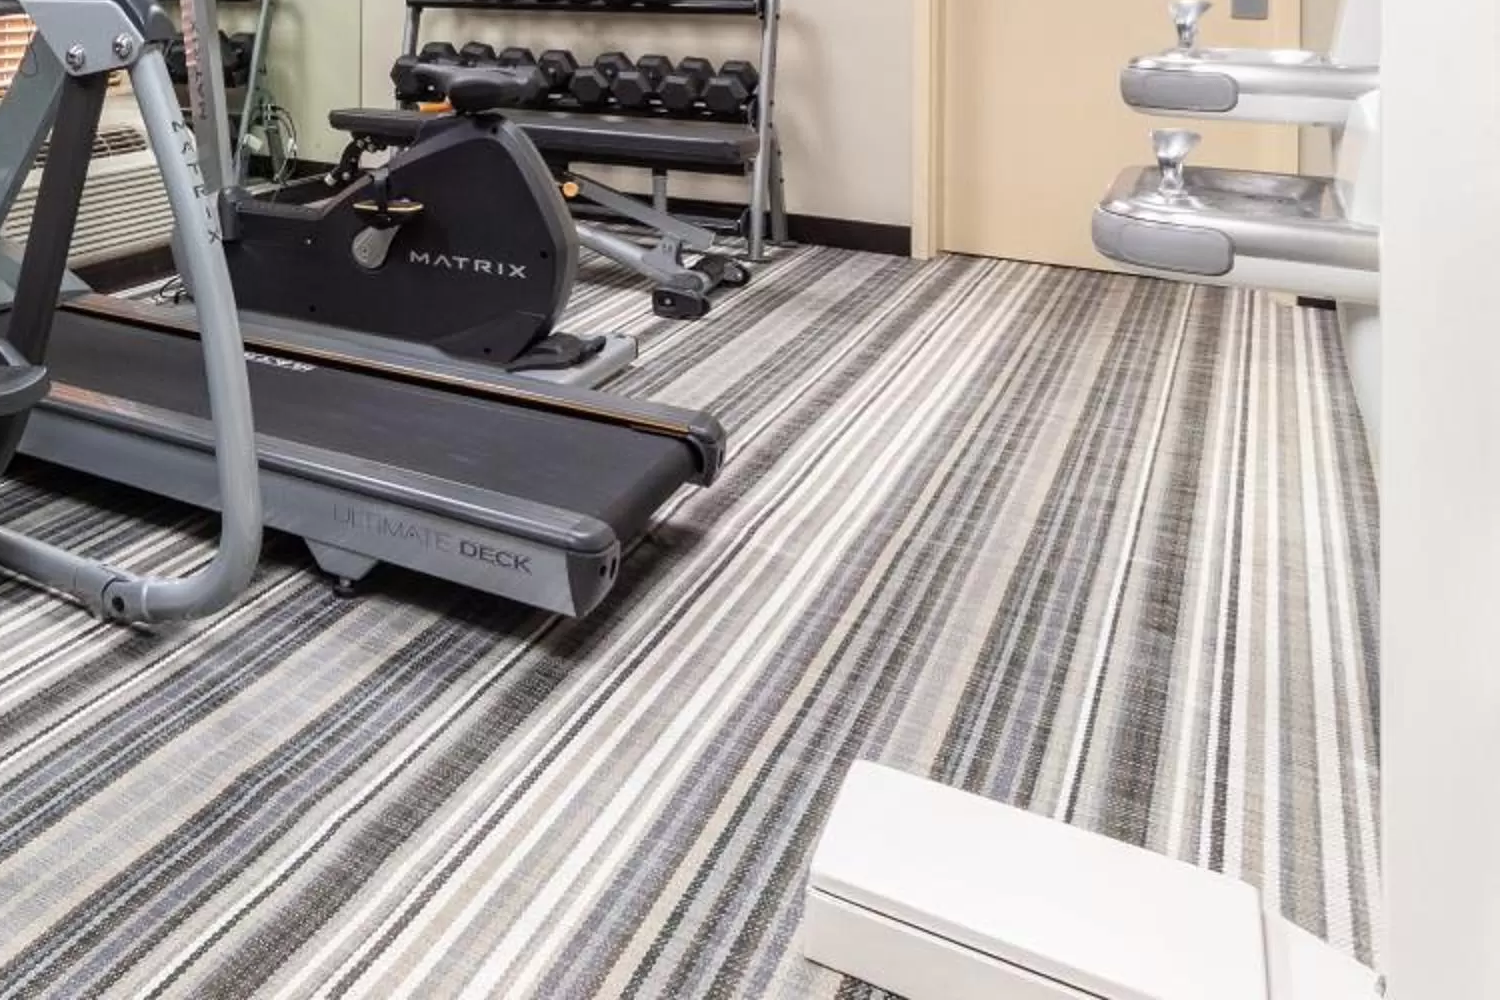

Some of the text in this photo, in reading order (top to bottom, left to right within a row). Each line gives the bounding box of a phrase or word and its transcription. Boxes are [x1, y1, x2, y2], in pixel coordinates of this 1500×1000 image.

[409, 250, 528, 279] MATRIX
[333, 503, 533, 576] ULTIMATE DECK
